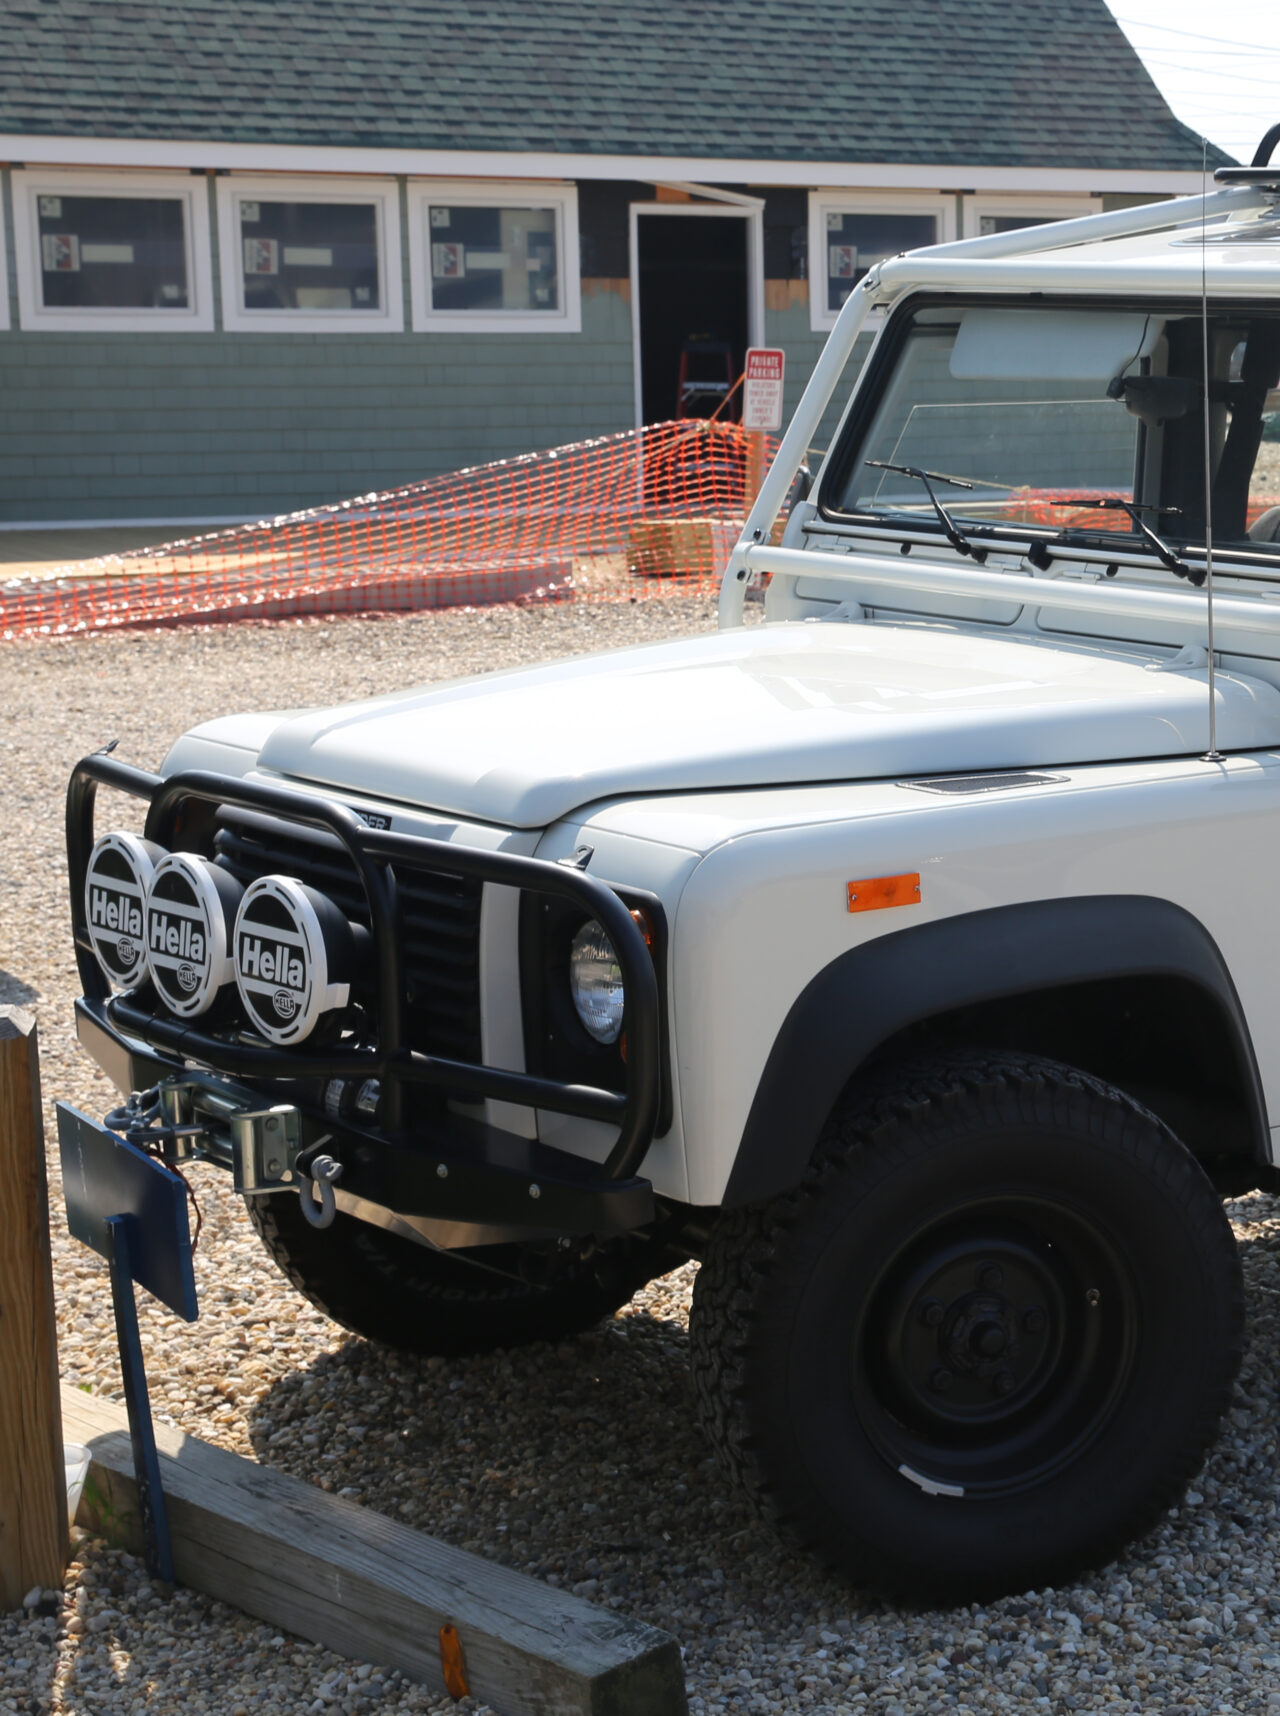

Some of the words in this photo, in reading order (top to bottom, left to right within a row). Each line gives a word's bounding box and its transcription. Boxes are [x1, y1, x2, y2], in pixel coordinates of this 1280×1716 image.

[92, 887, 142, 937] Hella
[151, 912, 204, 963] Hella
[242, 936, 304, 989] Hella
[275, 997, 295, 1011] HELLA
